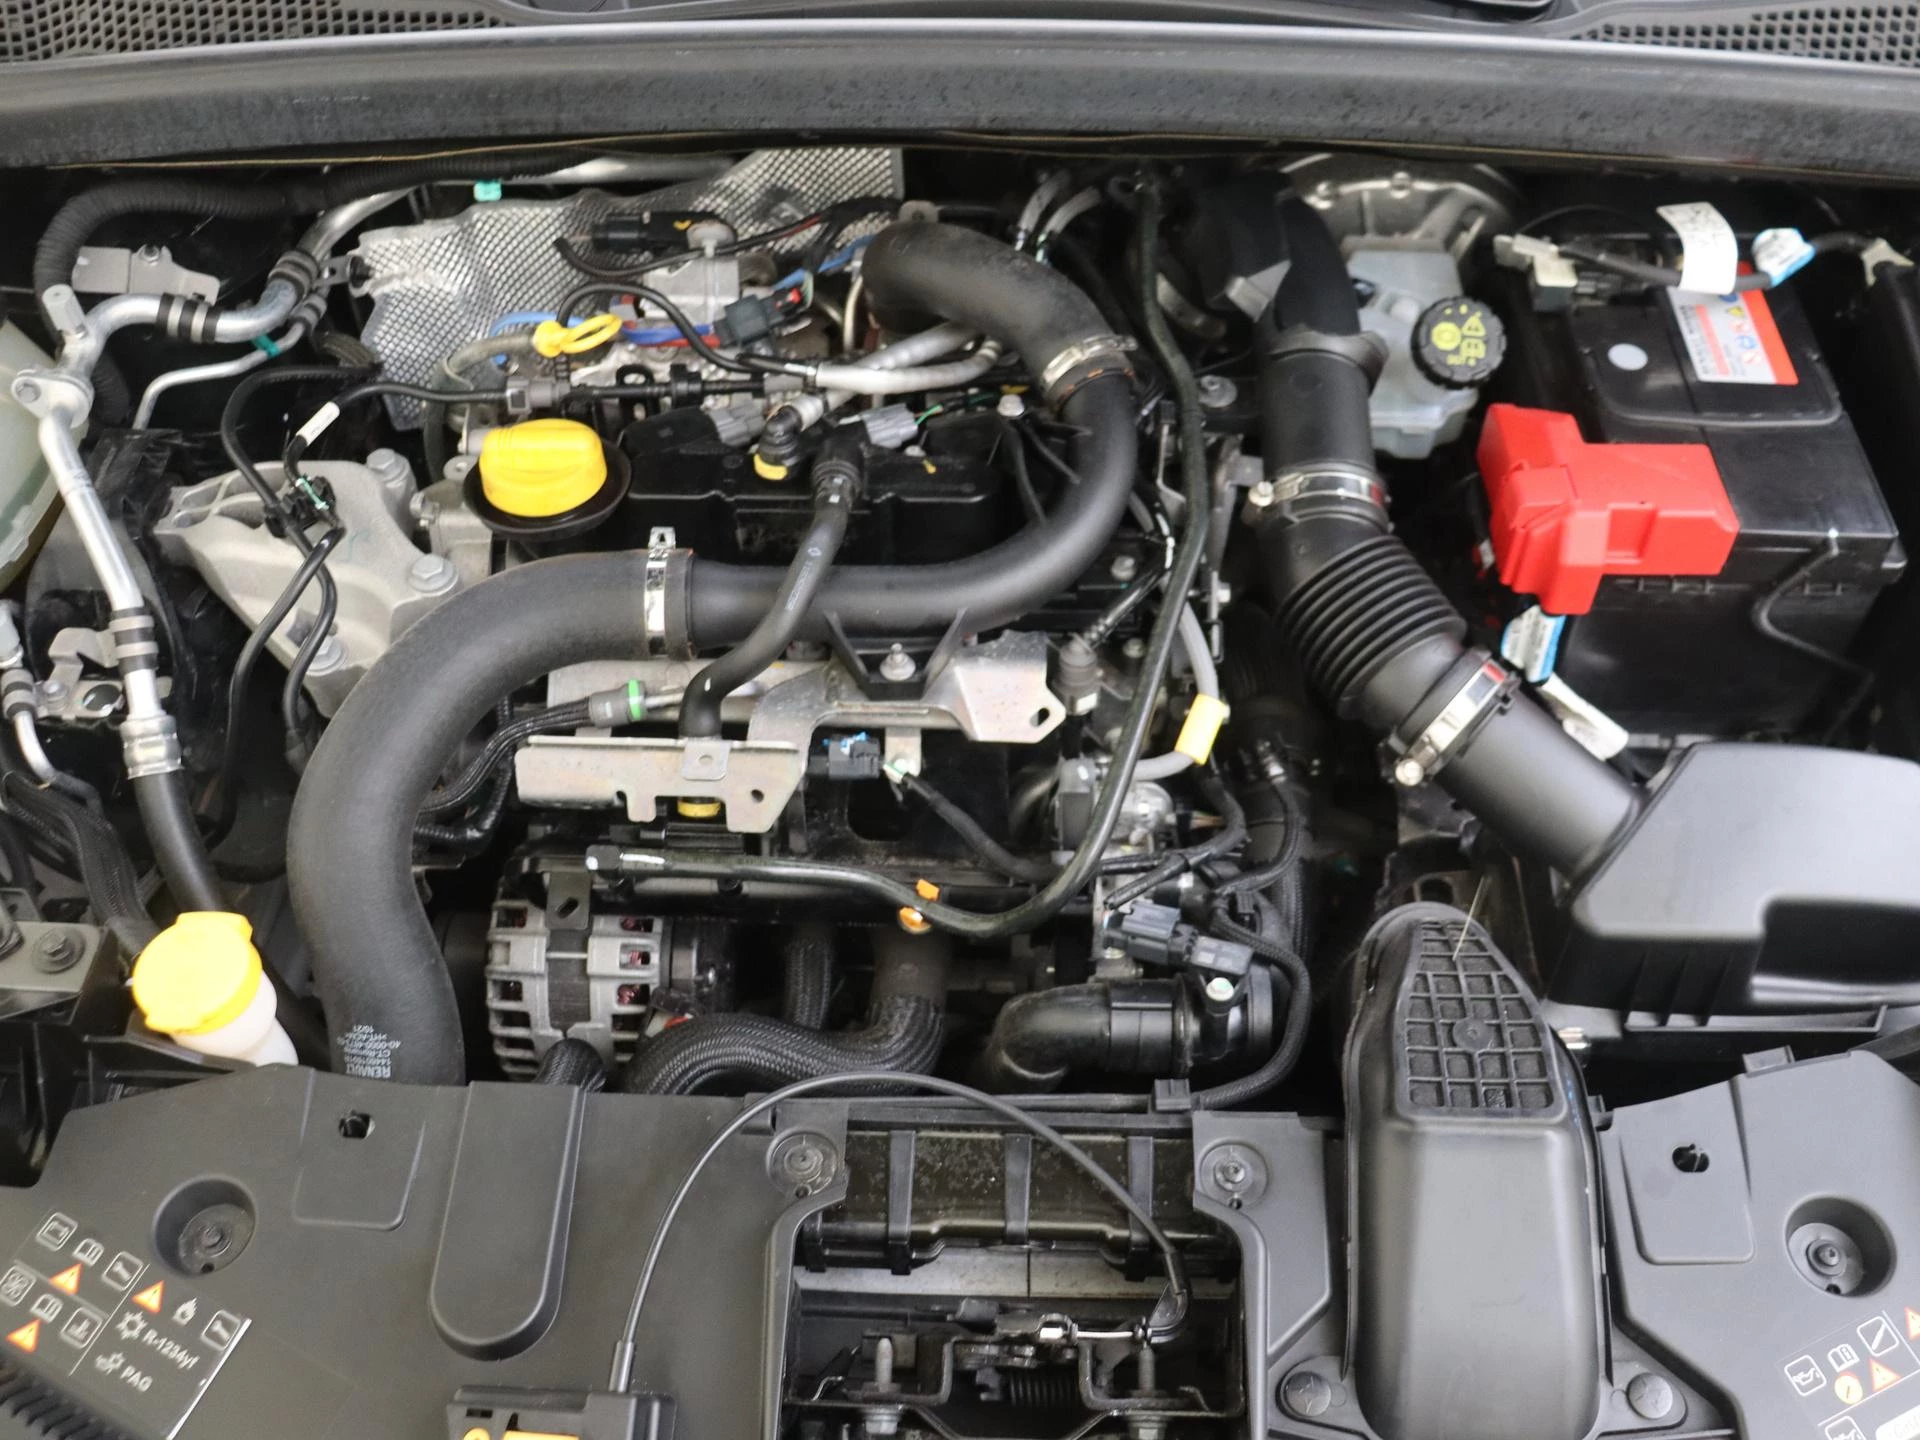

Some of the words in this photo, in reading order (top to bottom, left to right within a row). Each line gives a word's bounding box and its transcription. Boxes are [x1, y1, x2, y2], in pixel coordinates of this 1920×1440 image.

[346, 1063, 391, 1078] RENAULT
[141, 1328, 200, 1370] R-1234yf
[120, 1365, 153, 1392] PAG
